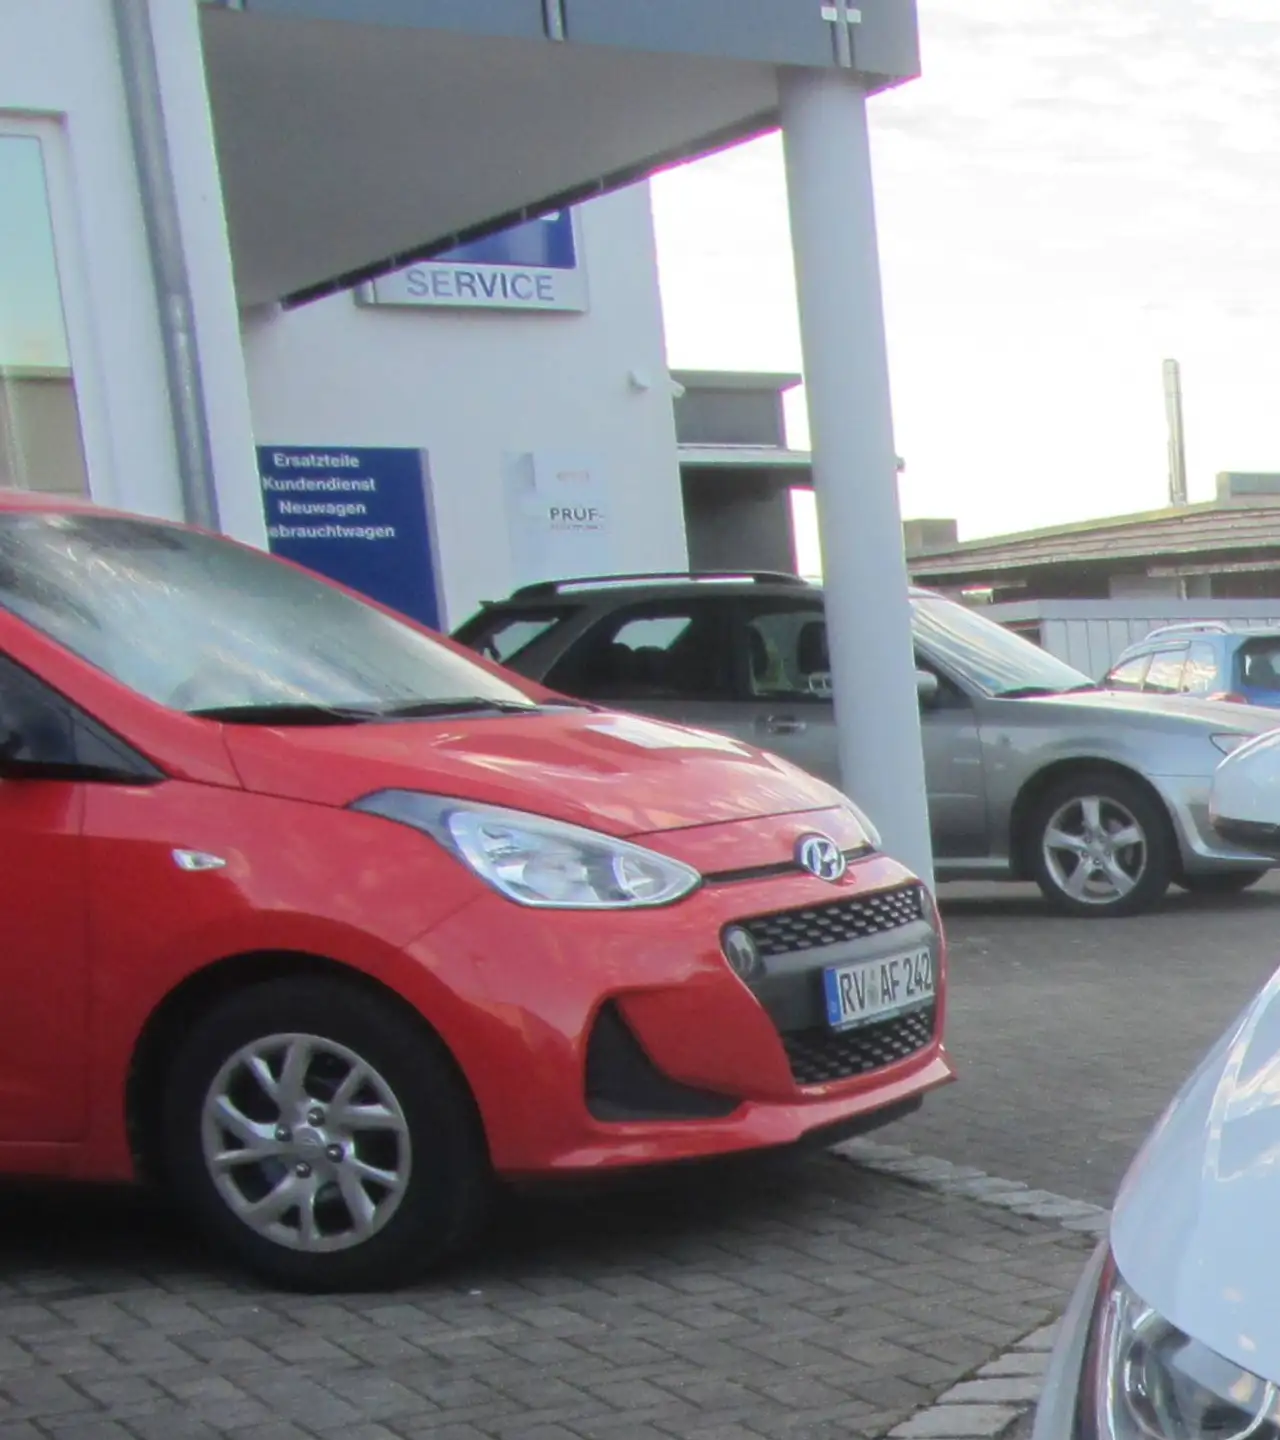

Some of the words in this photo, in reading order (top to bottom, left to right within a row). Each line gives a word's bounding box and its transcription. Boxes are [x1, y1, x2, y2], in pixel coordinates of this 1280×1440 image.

[406, 269, 555, 302] SERVICE
[273, 452, 360, 468] Ersatzteile
[262, 476, 376, 491] Kundendienst
[278, 500, 367, 517] Neuwagen
[268, 524, 395, 541] ebrauchtwagen
[839, 970, 866, 1015] RV
[880, 959, 900, 1005] AF
[903, 952, 932, 997] 242
